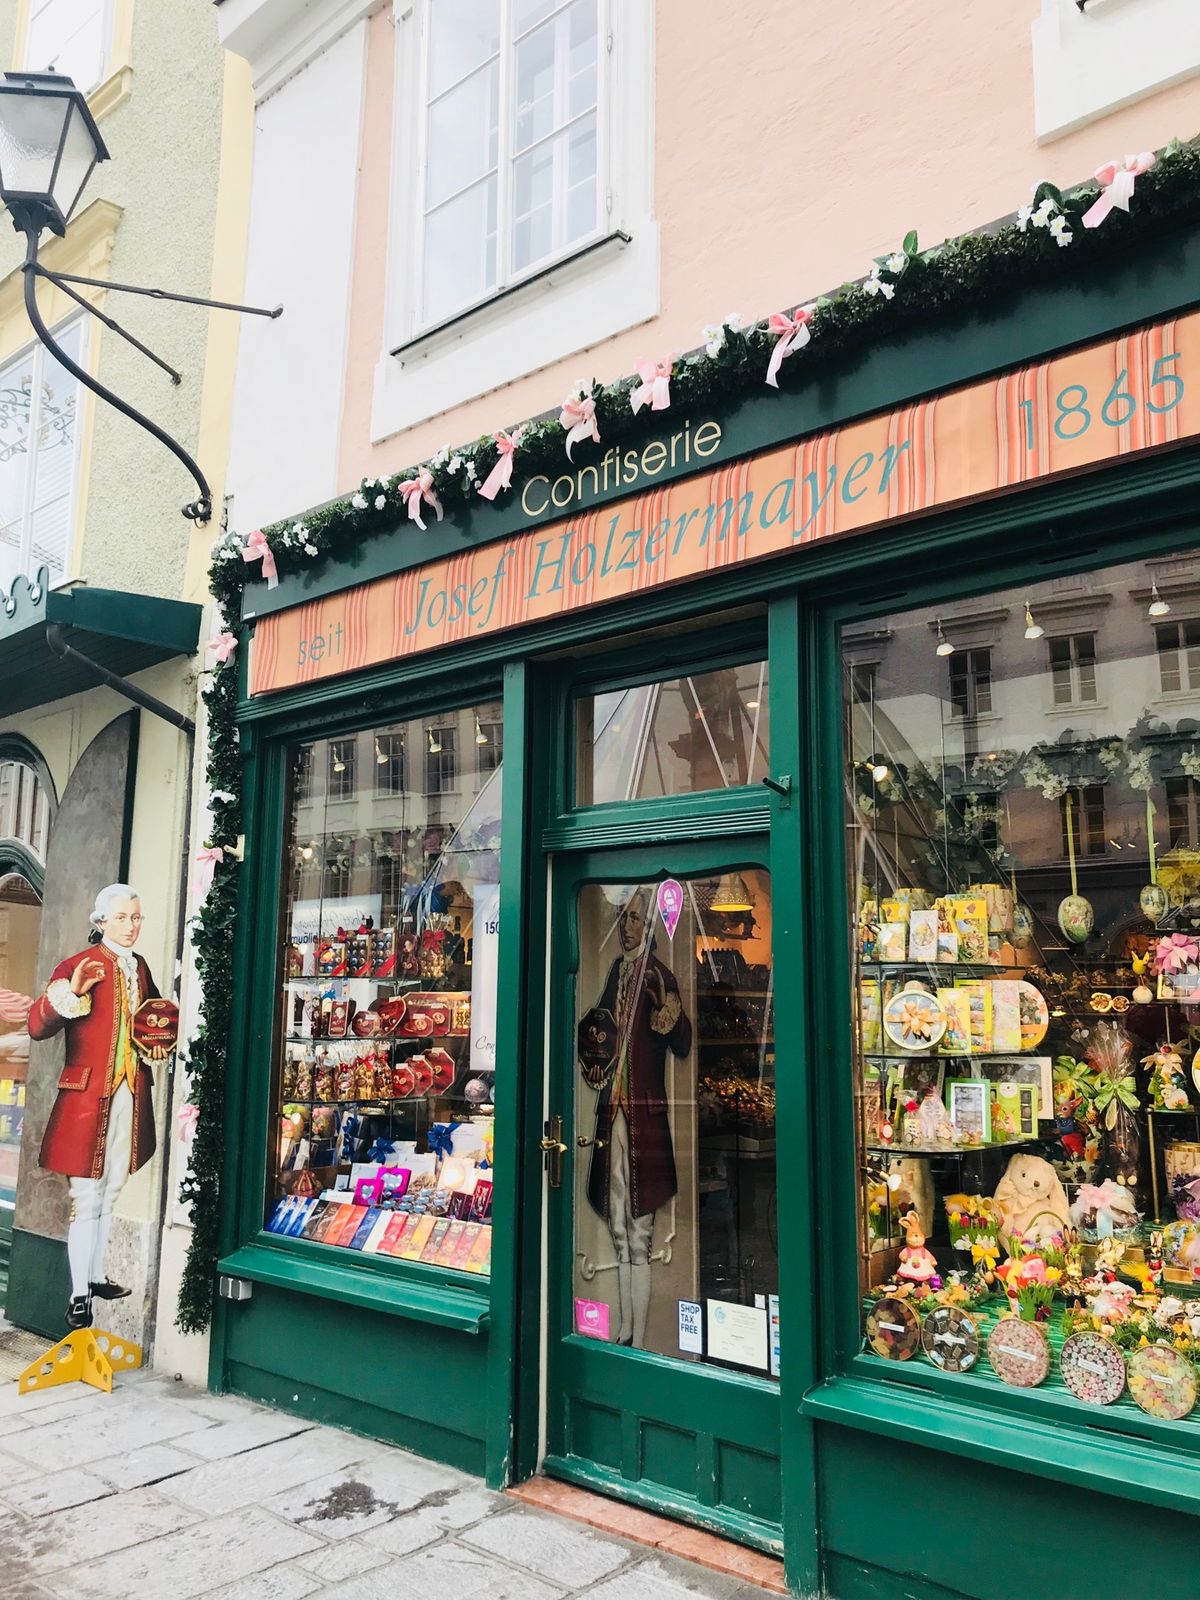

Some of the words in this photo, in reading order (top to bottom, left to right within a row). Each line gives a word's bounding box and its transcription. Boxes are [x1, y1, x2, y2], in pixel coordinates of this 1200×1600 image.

[521, 418, 722, 517] Confiserie
[297, 621, 343, 666] seit
[404, 547, 514, 635] Josef
[523, 438, 912, 600] Holzermayer
[1019, 352, 1185, 450] 1865
[680, 1303, 700, 1315] SHOP
[680, 1313, 695, 1325] TAX
[680, 1324, 699, 1335] FREE
